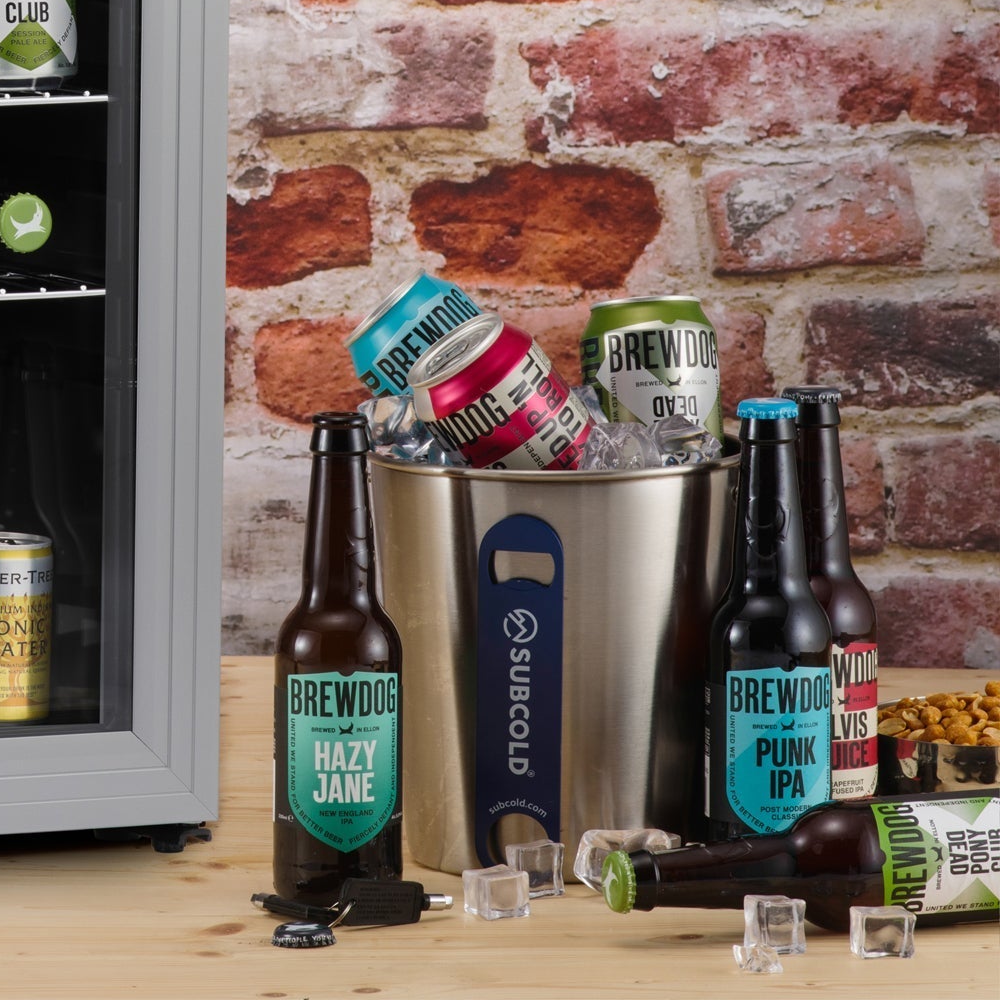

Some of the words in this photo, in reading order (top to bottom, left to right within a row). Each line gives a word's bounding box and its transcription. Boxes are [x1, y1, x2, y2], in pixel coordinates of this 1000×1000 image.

[5, 1, 49, 24] CLUB
[5, 49, 28, 63] BEER
[608, 329, 718, 373] BREWDOG
[521, 352, 563, 411] ROLL
[610, 377, 618, 408] UNITED
[557, 405, 582, 440] TO
[653, 395, 698, 418] DEAD
[290, 677, 395, 718] BREWDOG
[729, 672, 830, 715] BREWDOG
[311, 726, 335, 734] BREWED
[314, 740, 377, 772] HAZY
[756, 736, 817, 768] PUNK
[313, 772, 375, 804] JANE
[770, 770, 805, 799] IPA
[291, 793, 300, 813] FOR
[298, 809, 323, 834] BETTER
[323, 830, 344, 845] BEER
[349, 820, 380, 846] FIERCELY
[338, 809, 374, 817] ENGLAND
[340, 817, 354, 825] IPA
[488, 798, 548, 818] subcold.com
[731, 789, 741, 806] FOR
[738, 807, 765, 829] BETTER
[946, 830, 969, 876] DEAD
[966, 828, 990, 875] PONY
[925, 903, 953, 912] UNITED
[970, 900, 995, 909] STAND
